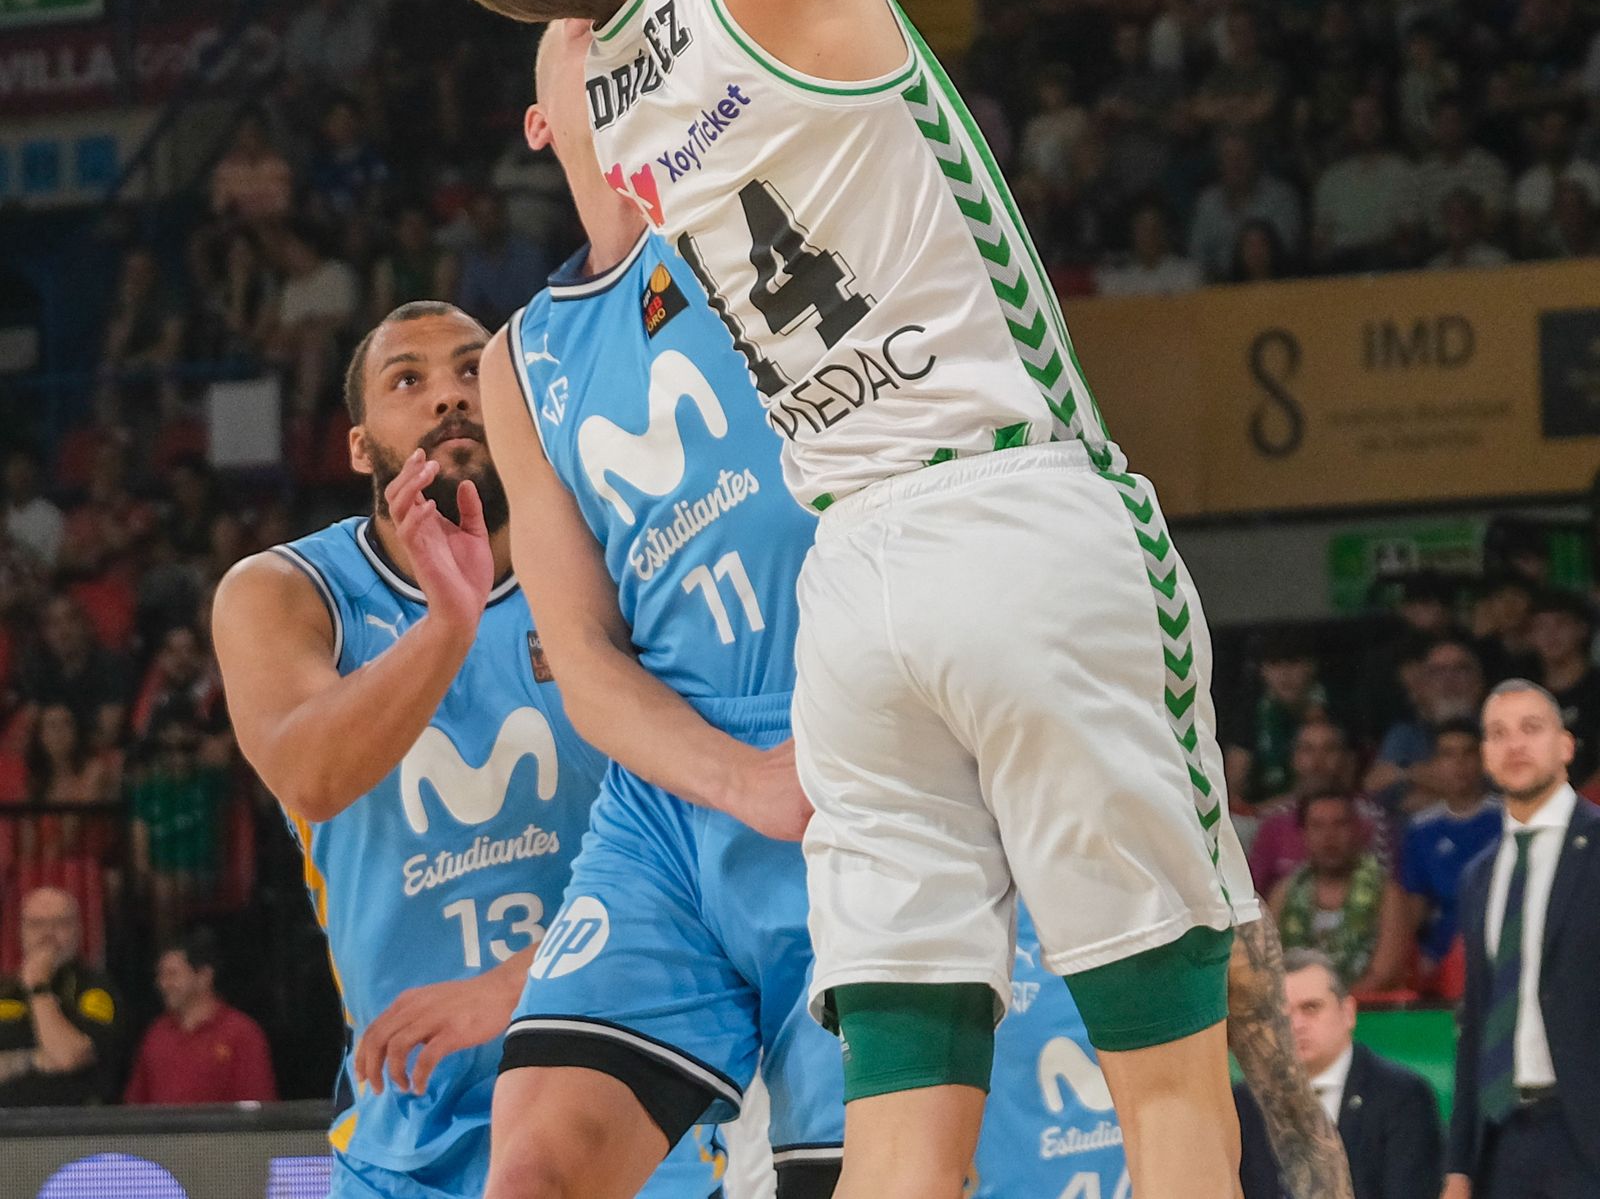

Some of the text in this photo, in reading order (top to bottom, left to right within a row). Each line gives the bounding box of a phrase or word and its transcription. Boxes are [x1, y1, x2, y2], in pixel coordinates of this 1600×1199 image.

[656, 83, 752, 184] XoyTicket
[647, 306, 667, 332] ORO
[1361, 315, 1476, 371] IMD
[628, 467, 760, 581] Estudiantes
[681, 550, 766, 645] 11
[402, 823, 560, 896] Estudiantes
[442, 892, 548, 968] 13
